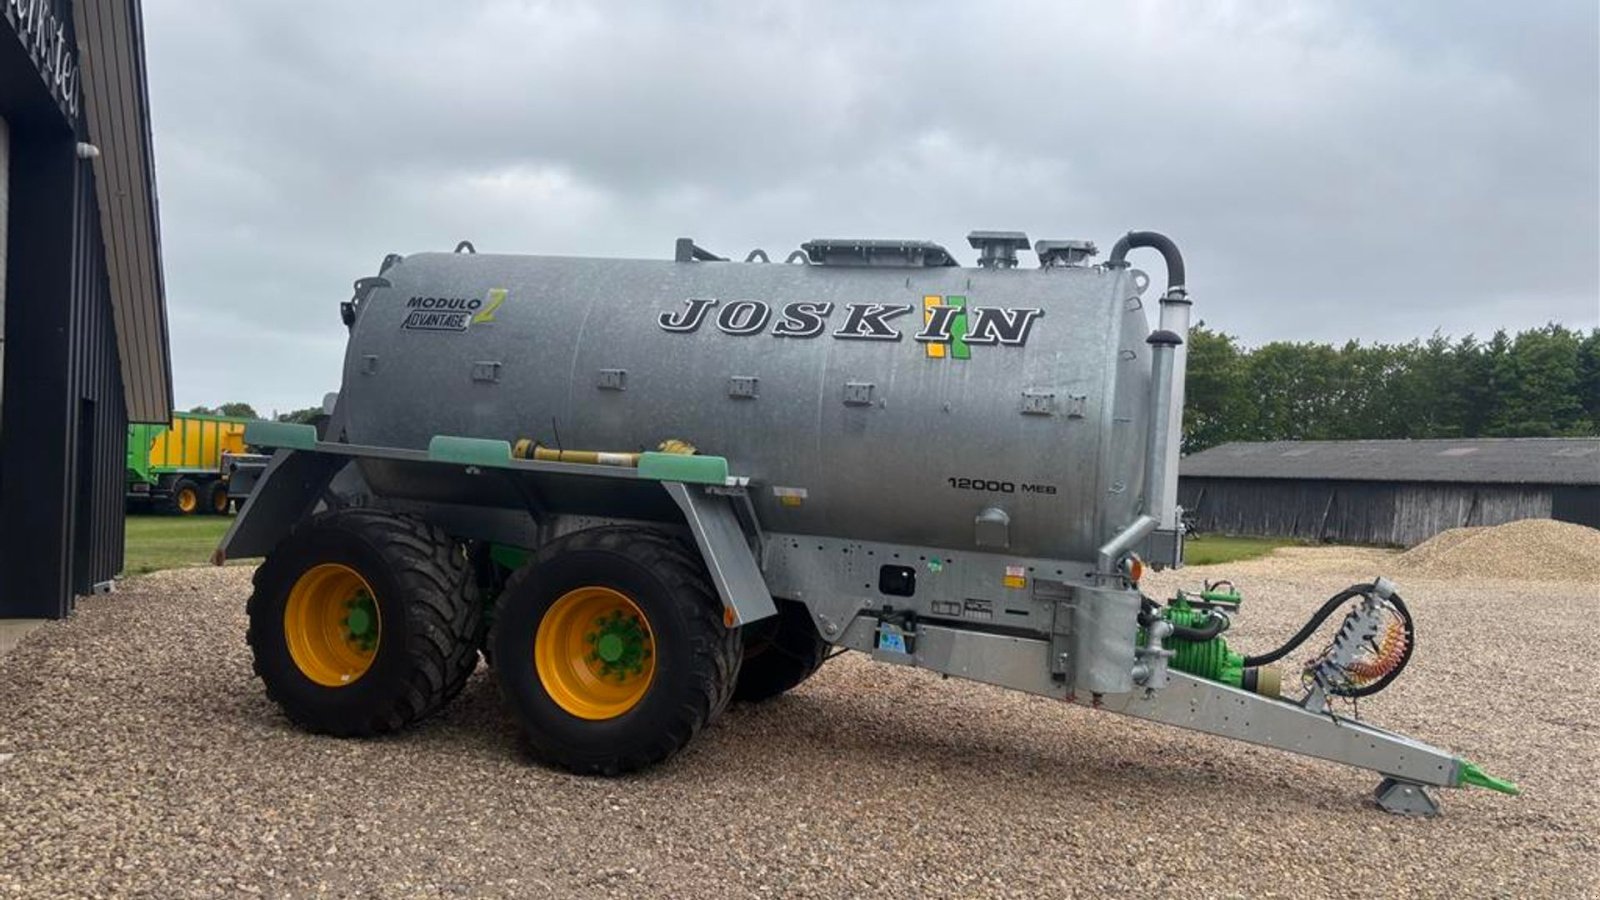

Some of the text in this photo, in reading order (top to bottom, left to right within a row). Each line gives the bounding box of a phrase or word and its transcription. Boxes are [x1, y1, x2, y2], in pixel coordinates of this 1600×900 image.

[406, 288, 508, 324] MODULO 2
[401, 311, 472, 331] ADVANTAGE
[657, 297, 1045, 347] JOSKIN
[947, 477, 1058, 495] 12000 MEB
